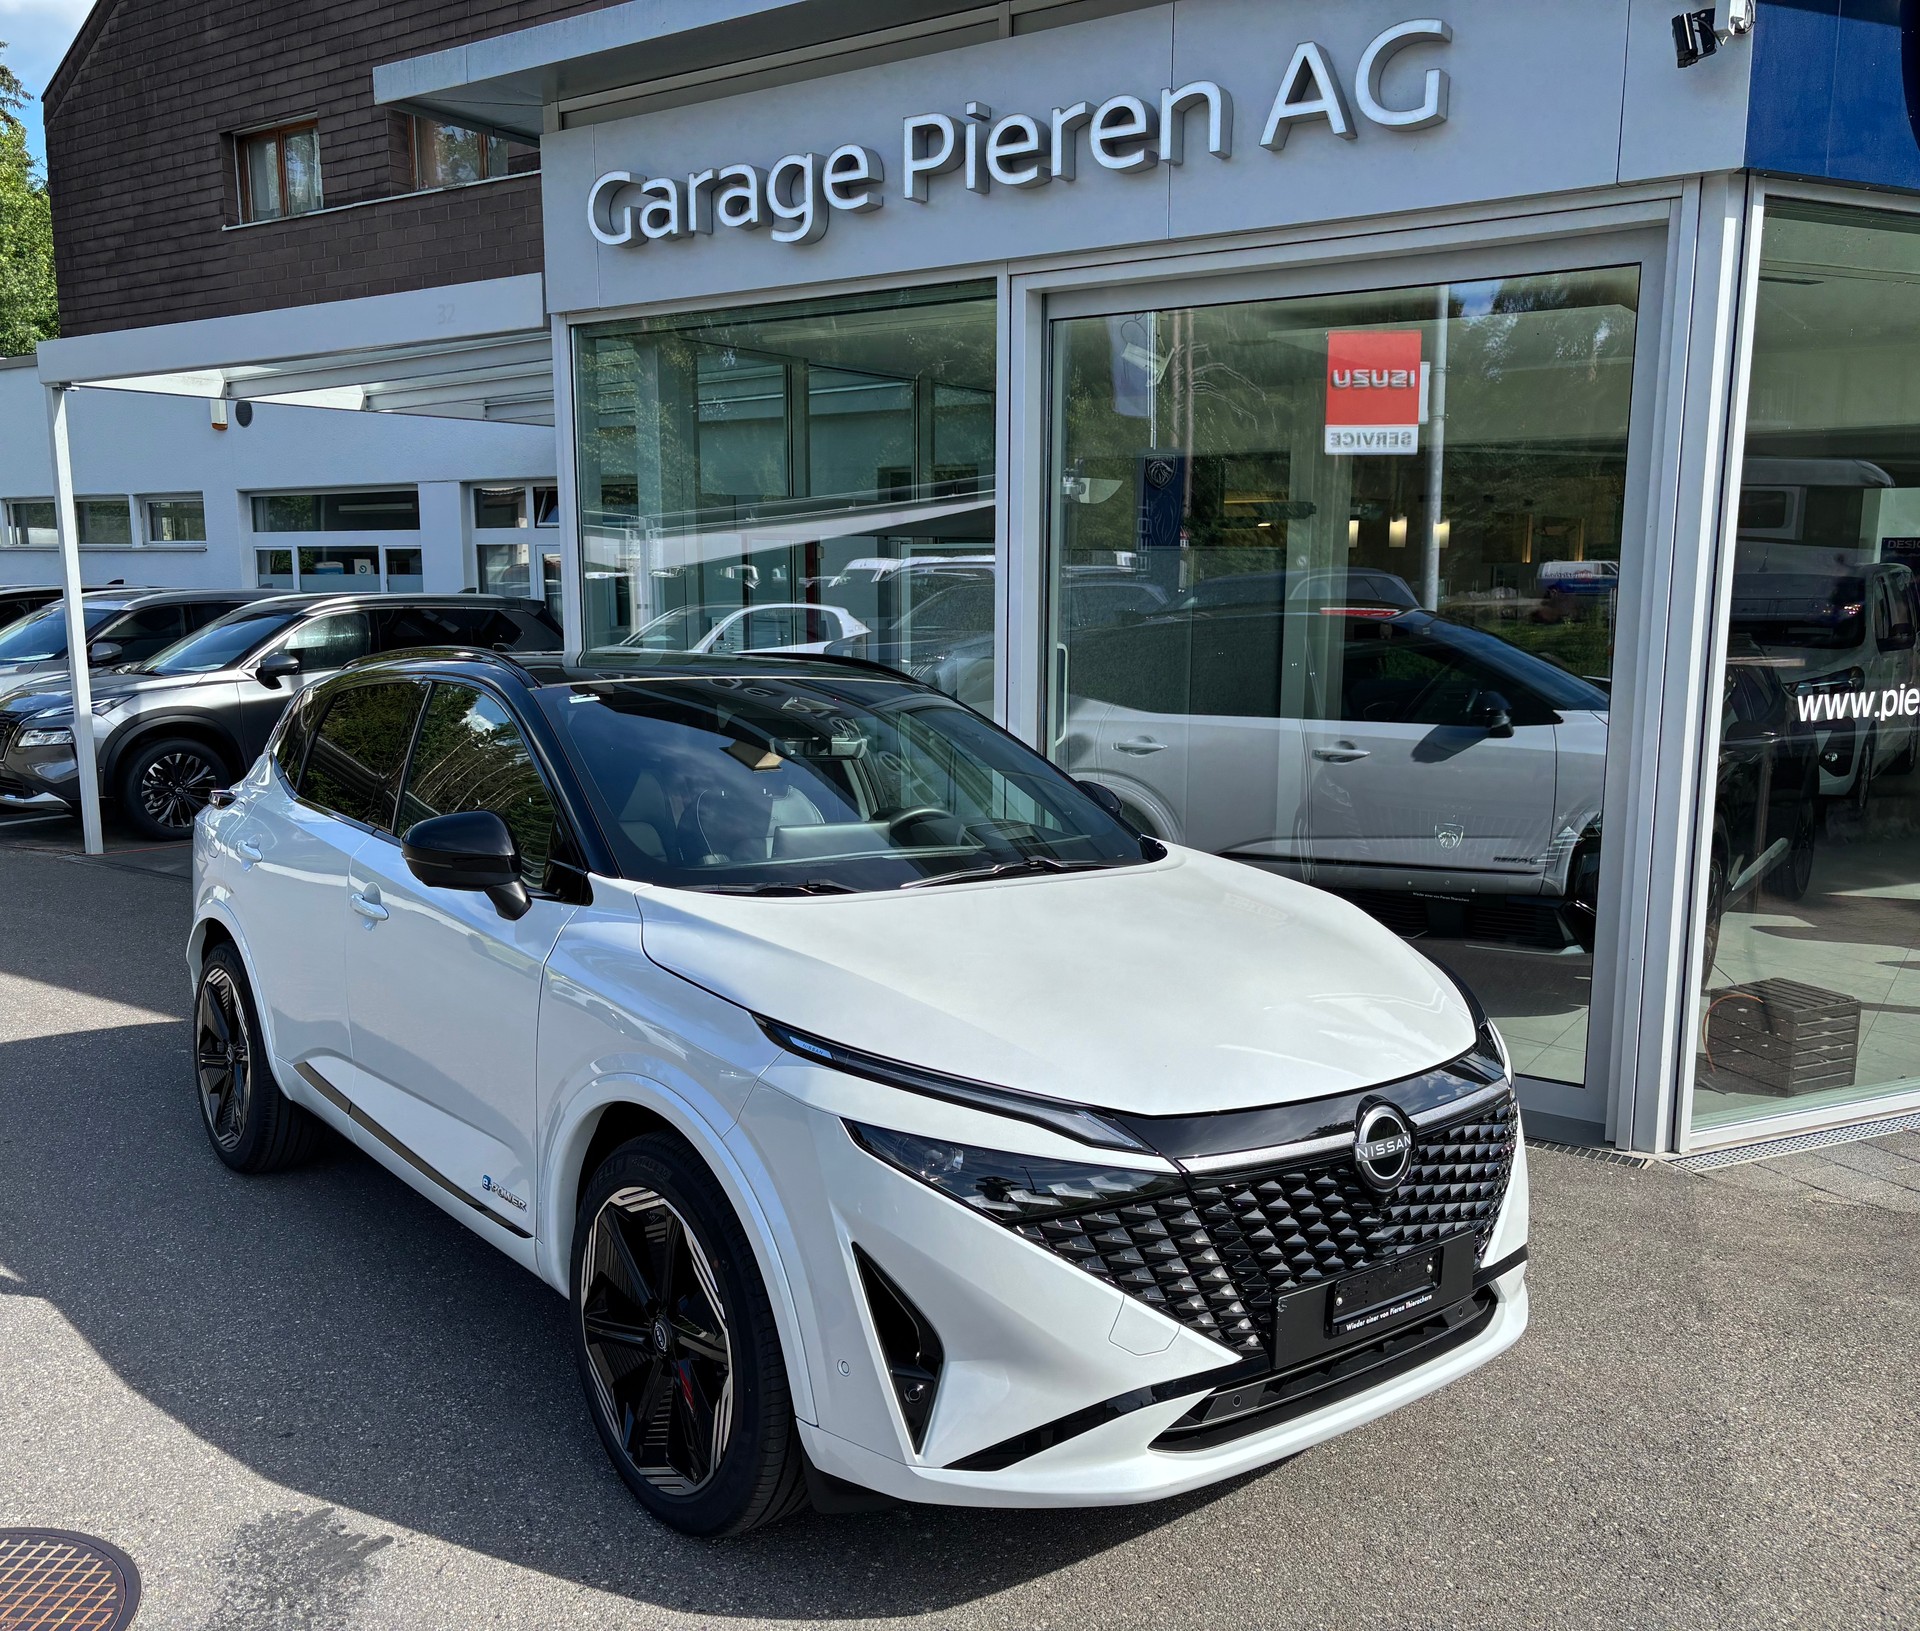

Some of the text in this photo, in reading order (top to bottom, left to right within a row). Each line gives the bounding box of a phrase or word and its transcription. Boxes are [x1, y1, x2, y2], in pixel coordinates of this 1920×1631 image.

[586, 18, 1453, 248] Garage Pieren AG
[437, 303, 457, 325] 32
[1797, 683, 1920, 722] www.pie
[1356, 1134, 1411, 1159] NISSAN
[1345, 1319, 1366, 1331] Wieder
[1366, 1315, 1379, 1324] einer
[1380, 1311, 1389, 1319] von
[1390, 1307, 1405, 1316] Pieren
